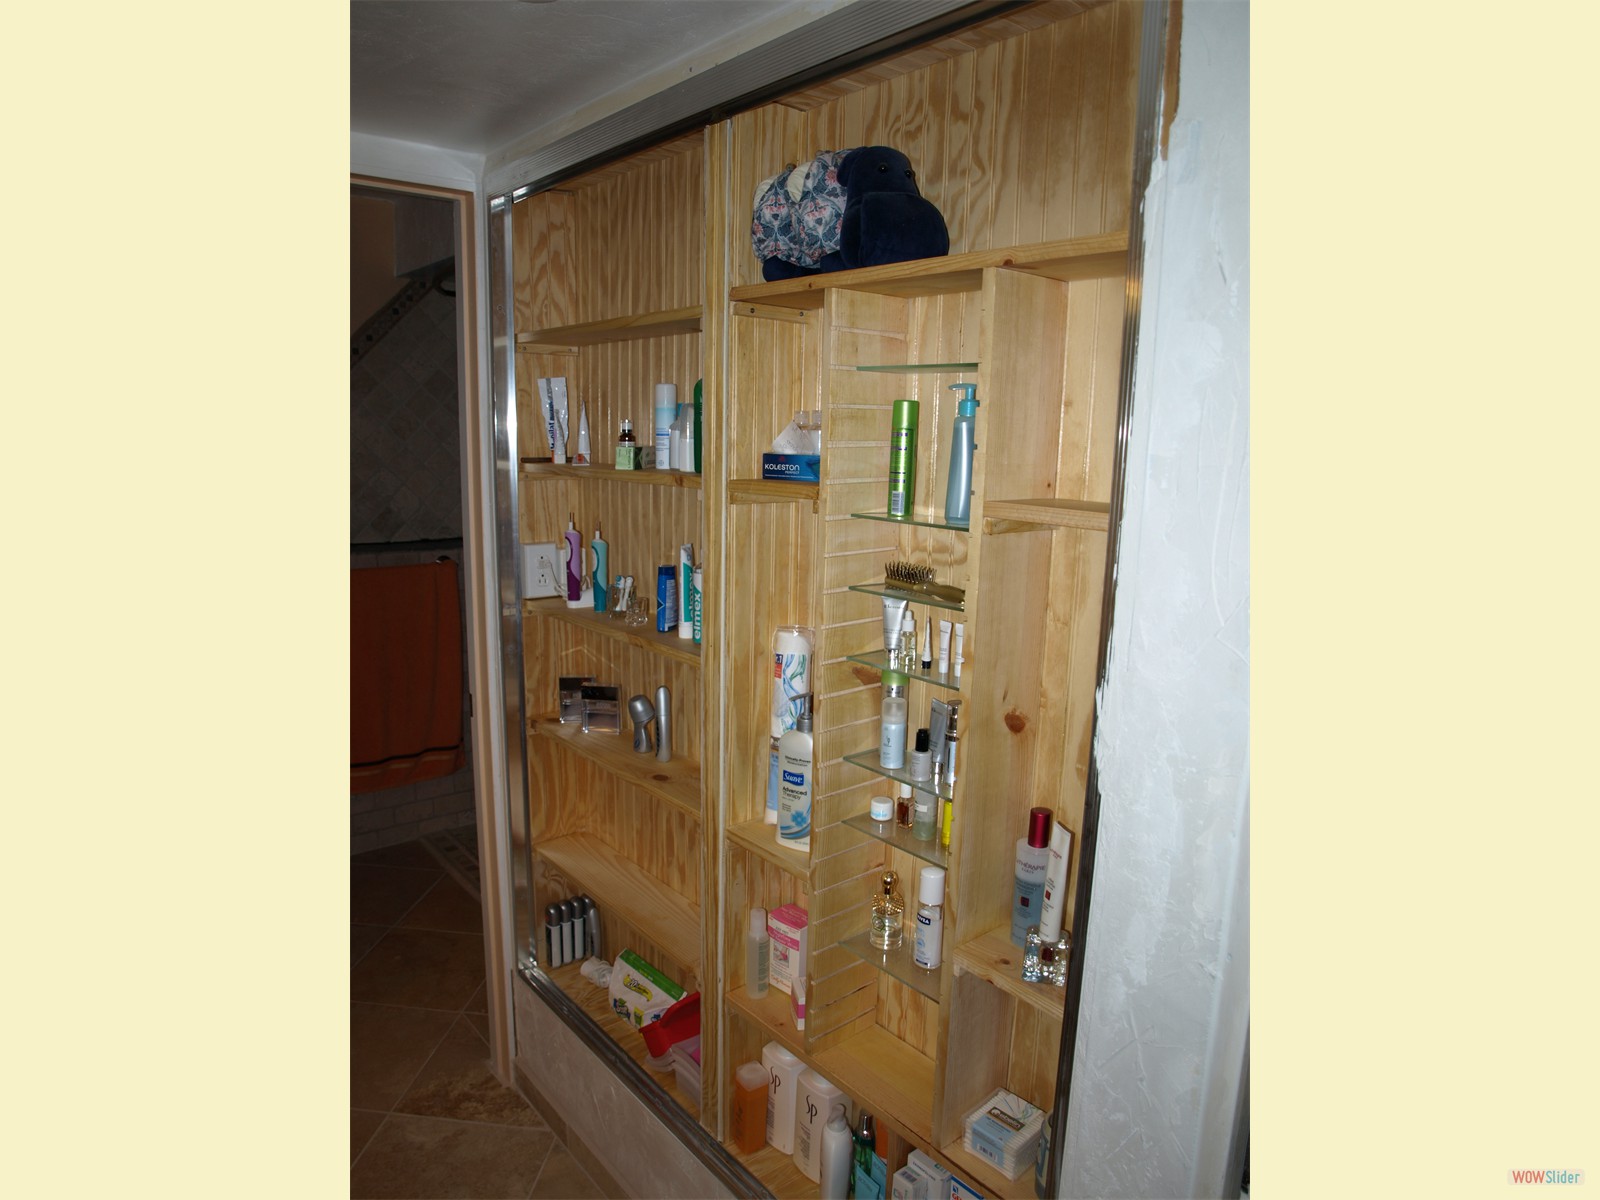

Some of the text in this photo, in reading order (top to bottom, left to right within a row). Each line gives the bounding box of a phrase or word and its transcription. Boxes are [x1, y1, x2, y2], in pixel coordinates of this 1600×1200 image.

[694, 593, 702, 640] elmex
[784, 772, 803, 784] Suave
[782, 786, 808, 796] Advanced
